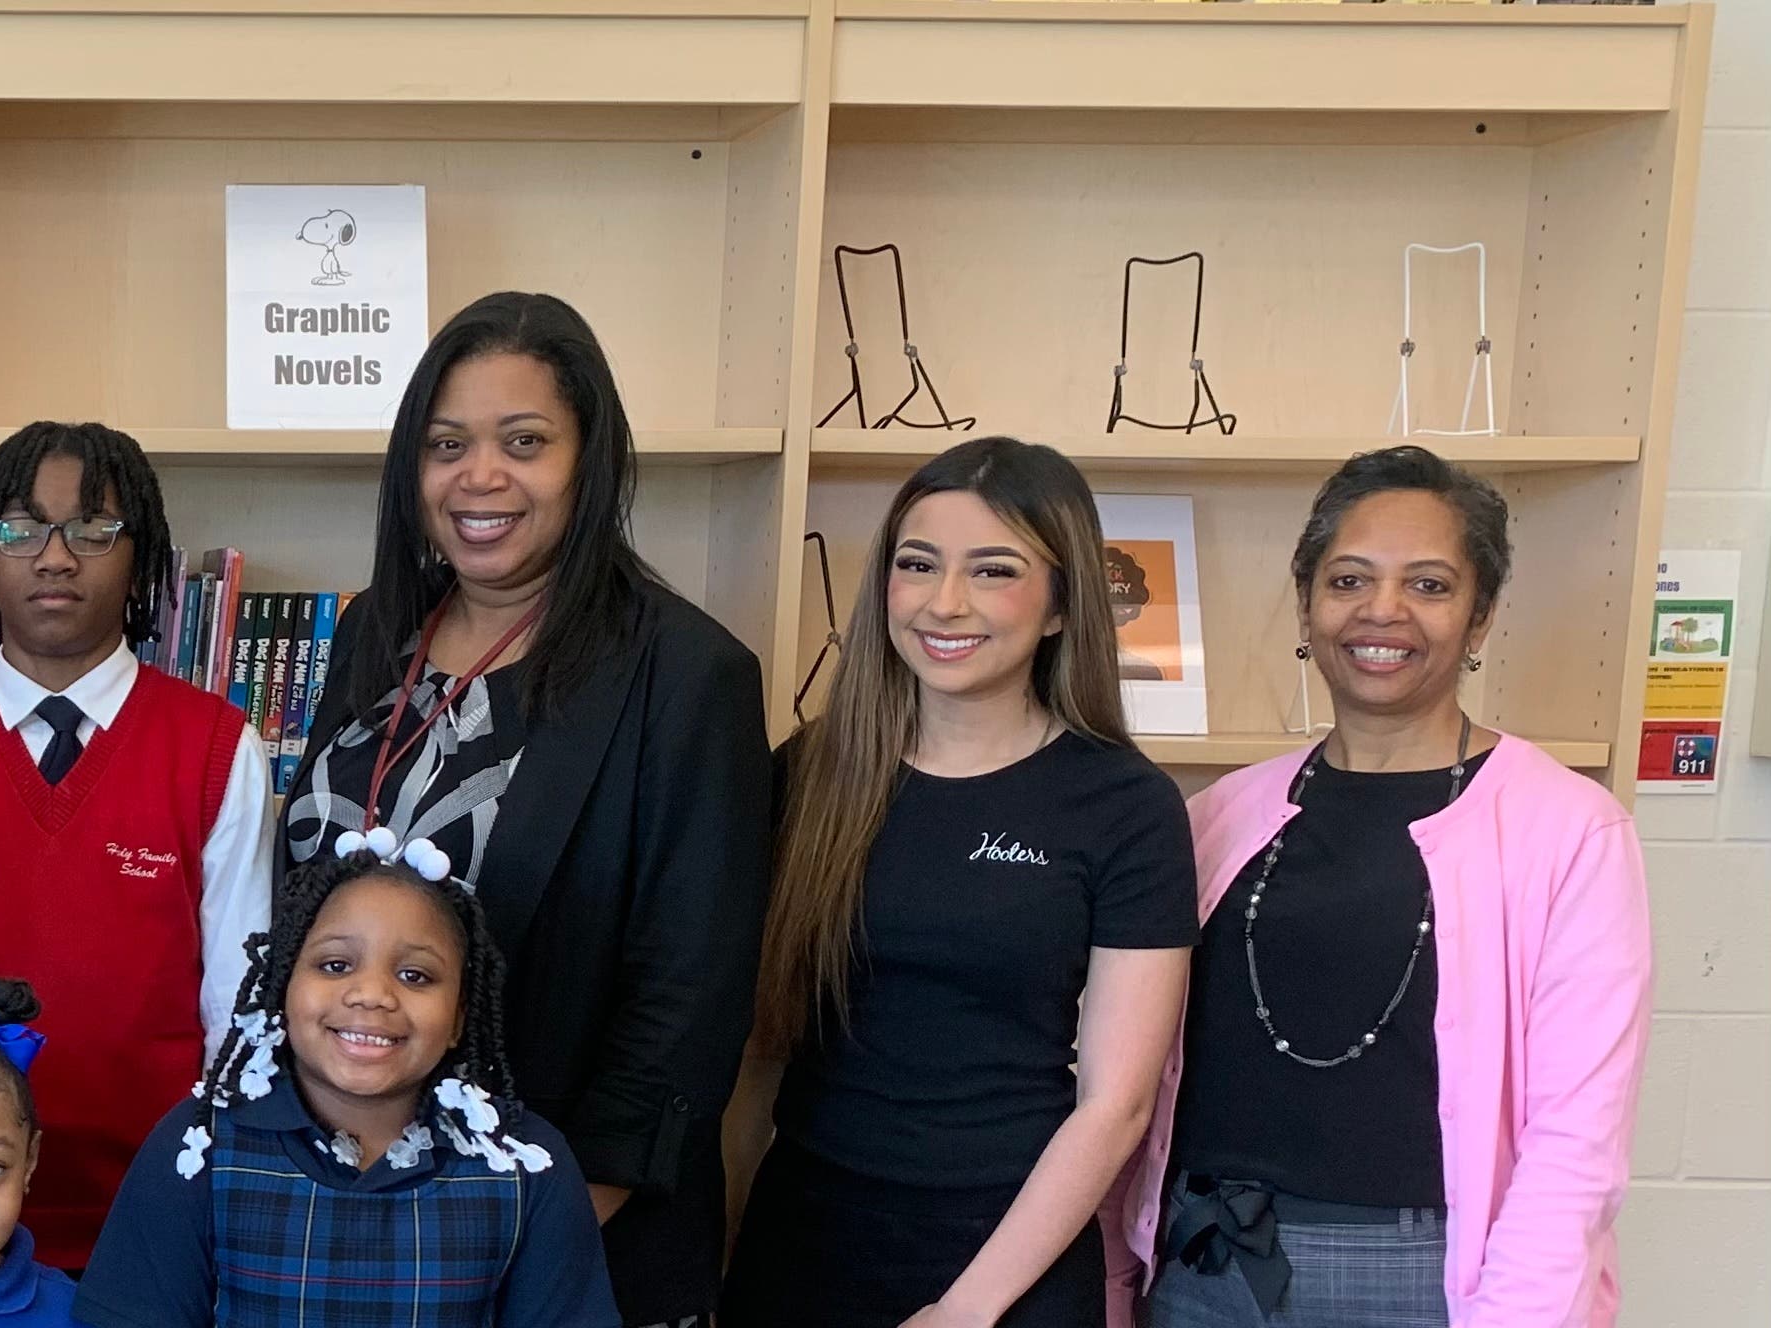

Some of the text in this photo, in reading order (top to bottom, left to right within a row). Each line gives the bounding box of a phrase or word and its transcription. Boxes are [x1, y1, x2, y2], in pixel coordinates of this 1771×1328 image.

[264, 302, 390, 336] Graphic
[275, 354, 382, 386] Novels
[234, 637, 252, 684] DOG MAN
[254, 637, 271, 661] DOG
[272, 637, 291, 684] DOG MAN
[293, 638, 311, 685] DOG MAN
[314, 637, 332, 684] DOG MAN
[253, 661, 266, 684] MAN
[1679, 758, 1707, 775] 911
[105, 842, 178, 866] Holy Family
[969, 831, 1050, 865] Hooters
[119, 862, 159, 879] School
